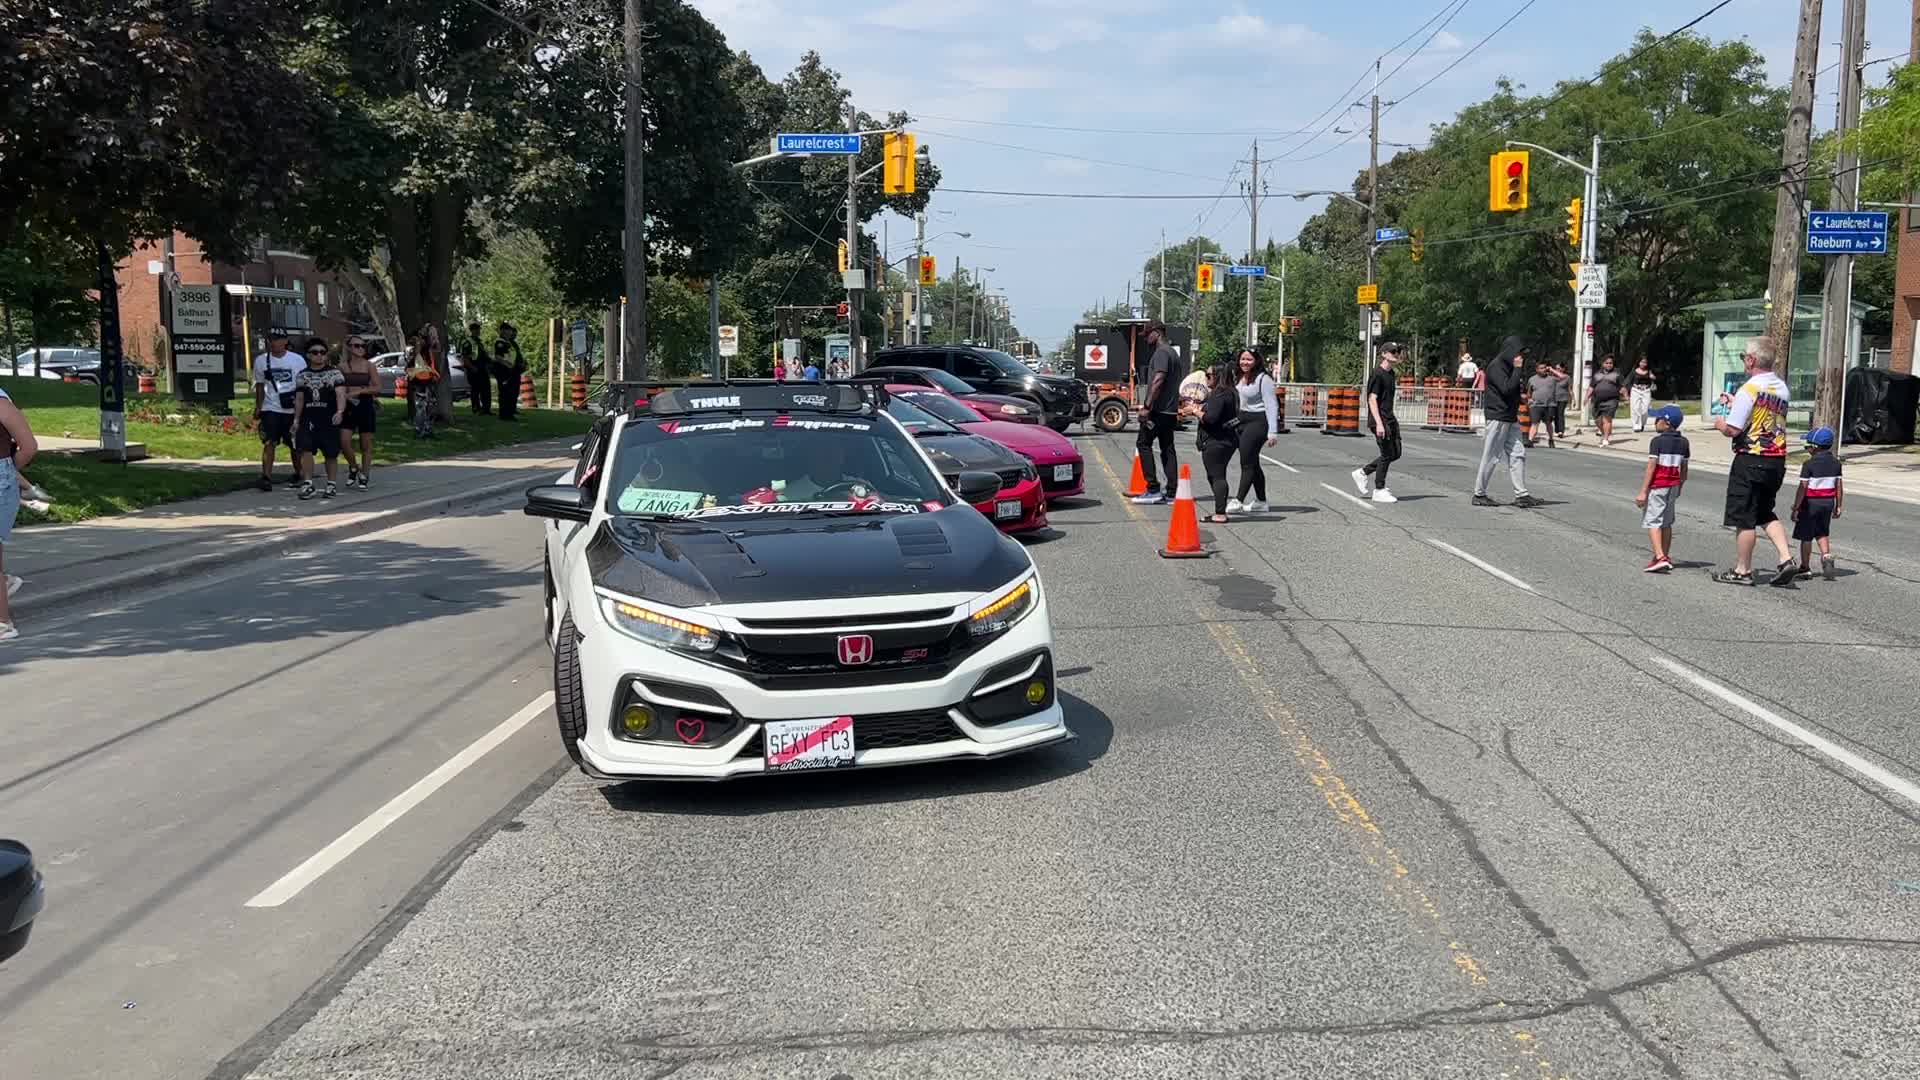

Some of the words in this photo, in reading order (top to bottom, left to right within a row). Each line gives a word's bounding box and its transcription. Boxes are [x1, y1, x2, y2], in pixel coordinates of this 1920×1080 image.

[781, 136, 844, 149] Laurelcrest
[1825, 216, 1870, 229] Laurelcrest
[1810, 235, 1852, 249] Raeburn
[180, 292, 211, 303] 3896
[689, 396, 742, 409] THULE
[633, 498, 691, 513] TANGA
[769, 732, 809, 756] SEXY
[821, 729, 850, 753] FC3
[780, 755, 827, 771] antisocial
